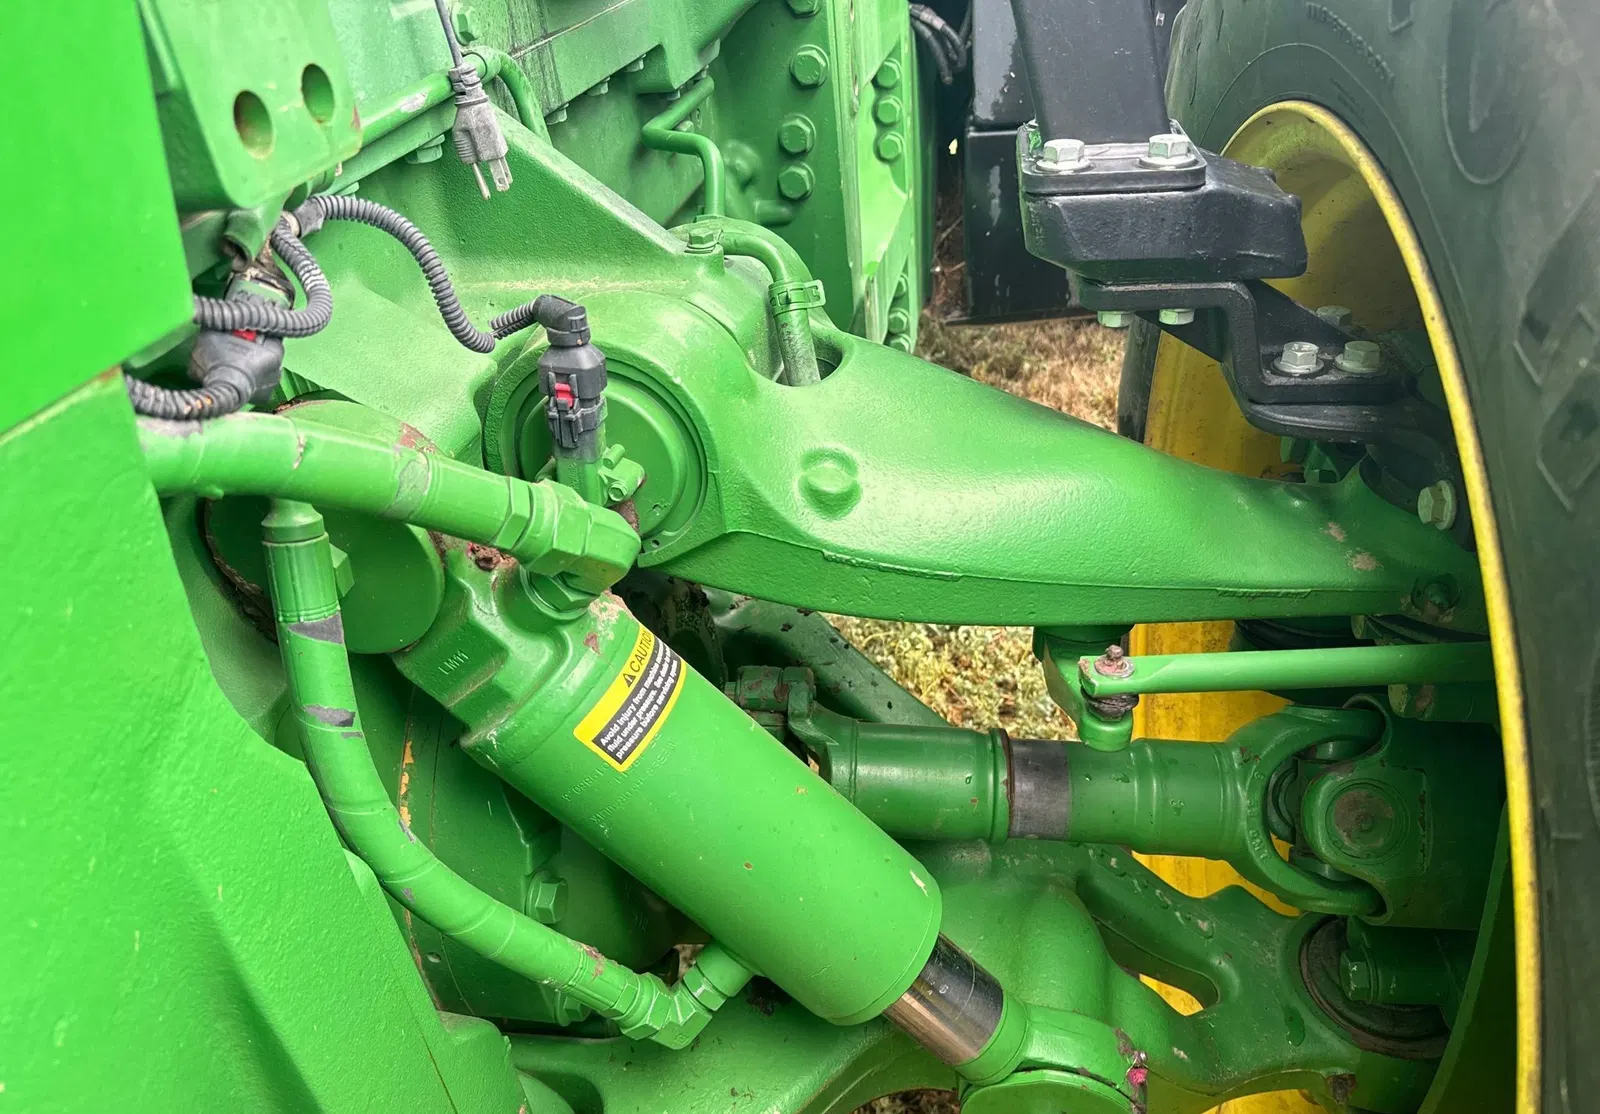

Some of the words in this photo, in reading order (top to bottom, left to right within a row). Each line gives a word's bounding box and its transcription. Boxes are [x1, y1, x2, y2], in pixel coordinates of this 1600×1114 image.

[600, 723, 620, 746] Avoid
[616, 703, 637, 726] injury
[632, 687, 647, 704] from
[607, 735, 624, 753] fluid
[620, 716, 638, 737] under
[615, 726, 644, 760] pressure
[640, 704, 659, 728] before
[656, 676, 675, 705] servicing
